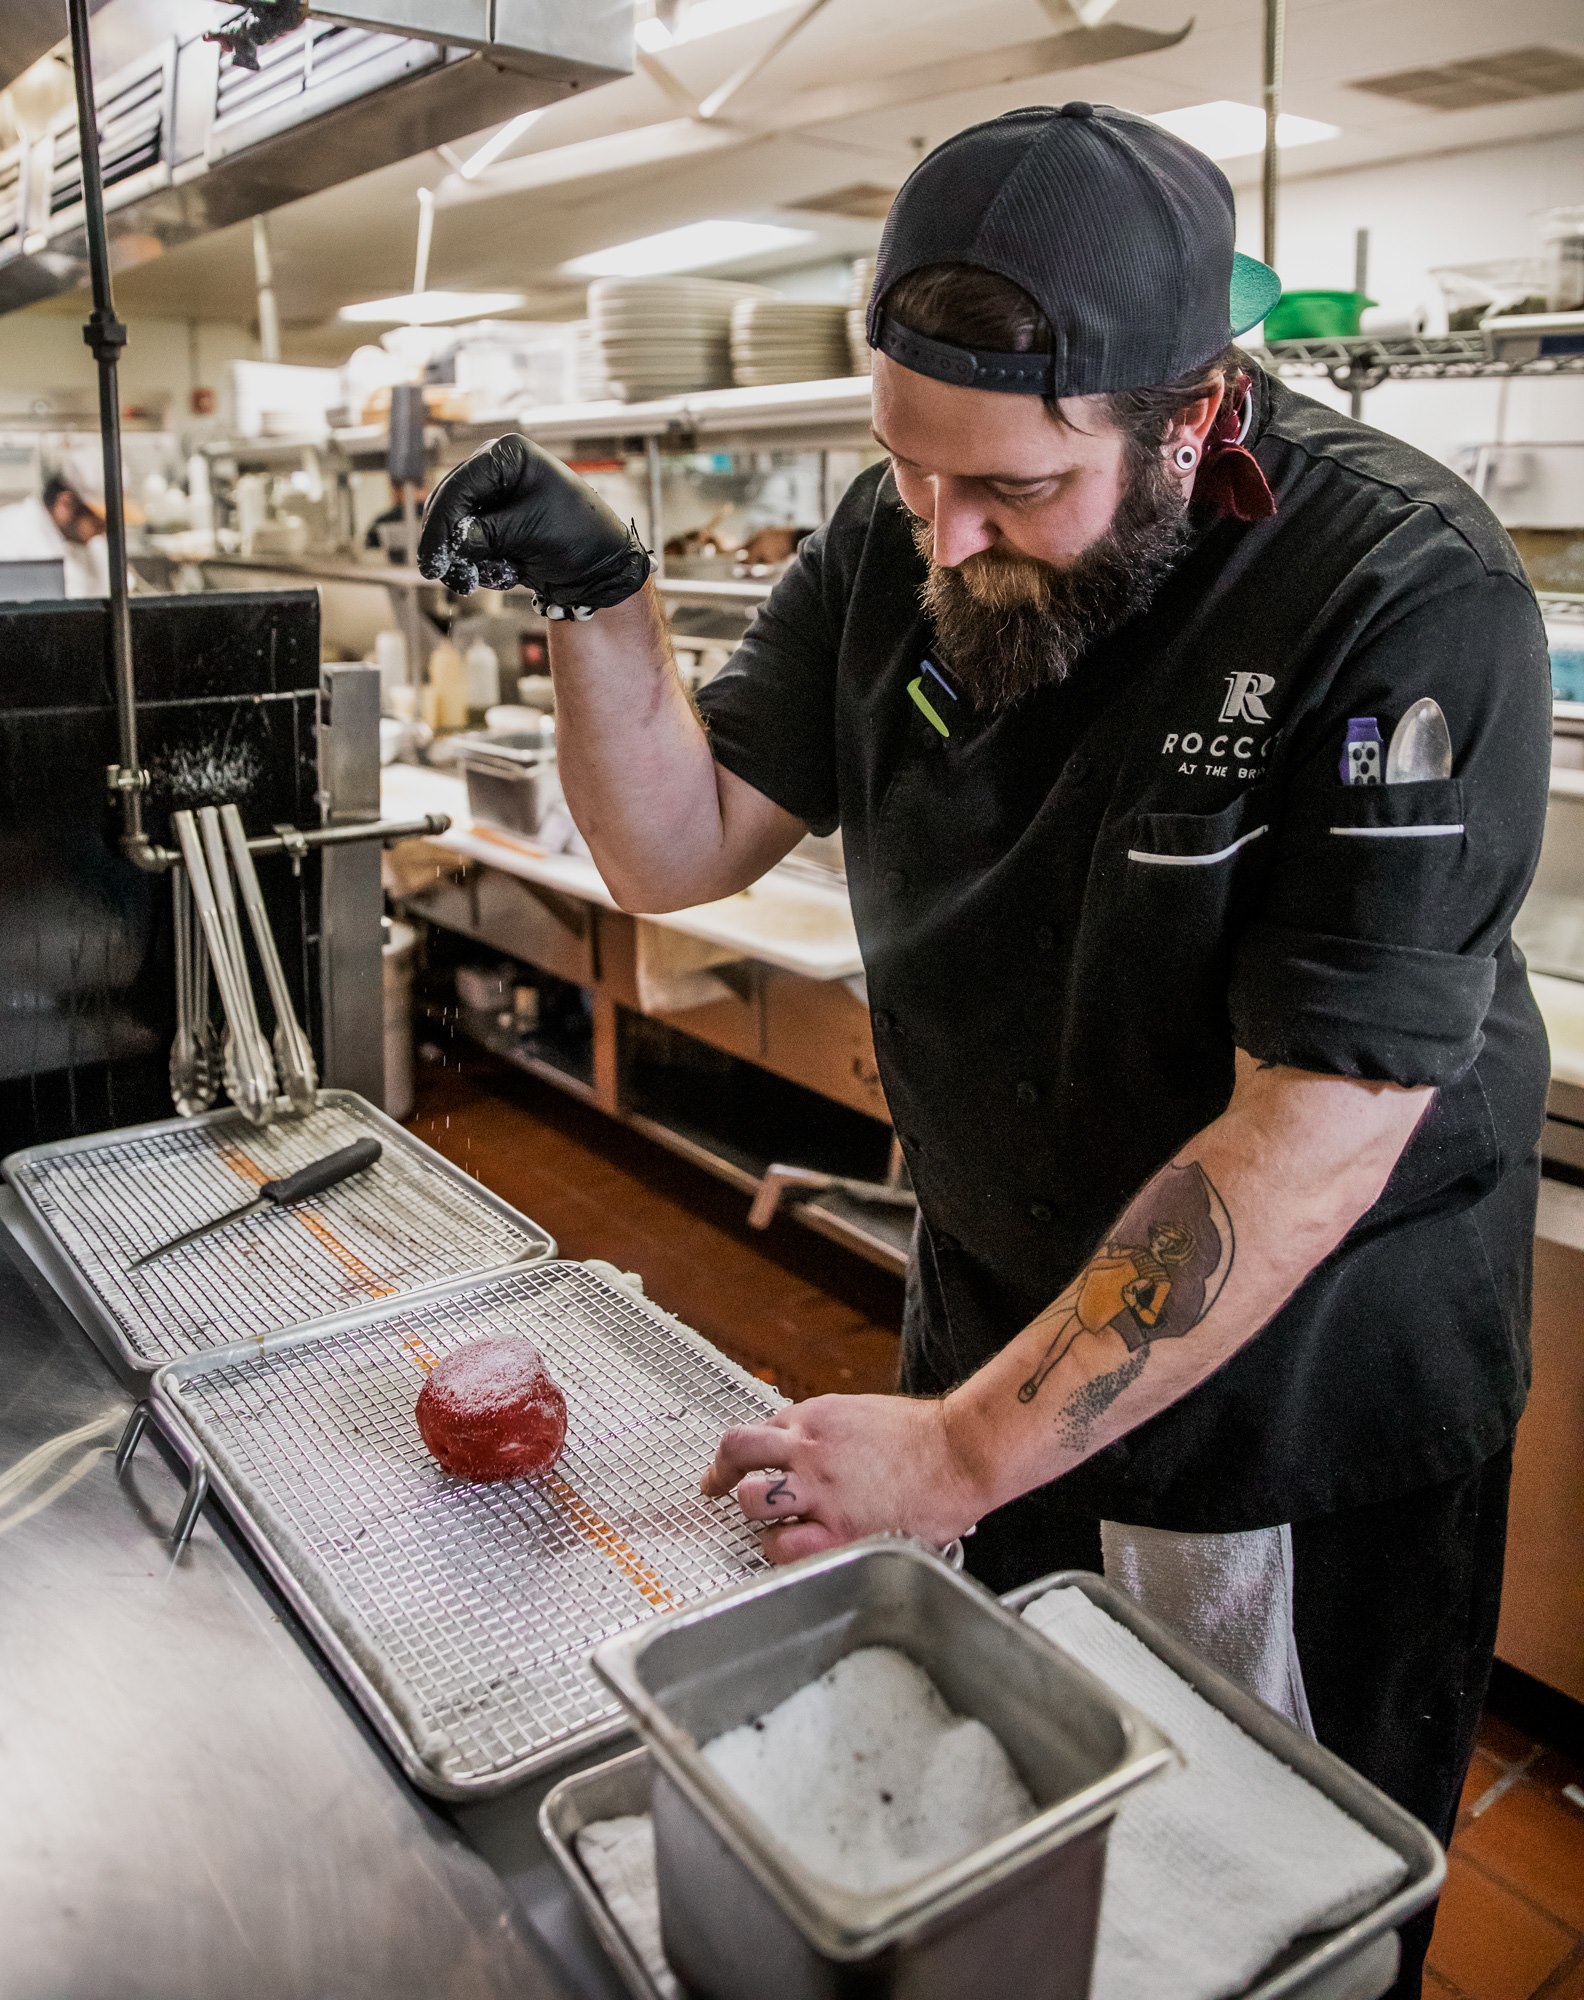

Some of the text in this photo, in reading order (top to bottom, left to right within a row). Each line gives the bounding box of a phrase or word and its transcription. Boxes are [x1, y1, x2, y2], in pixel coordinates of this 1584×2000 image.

[1218, 671, 1275, 724] R
[1178, 762, 1265, 779] AT THE BR
